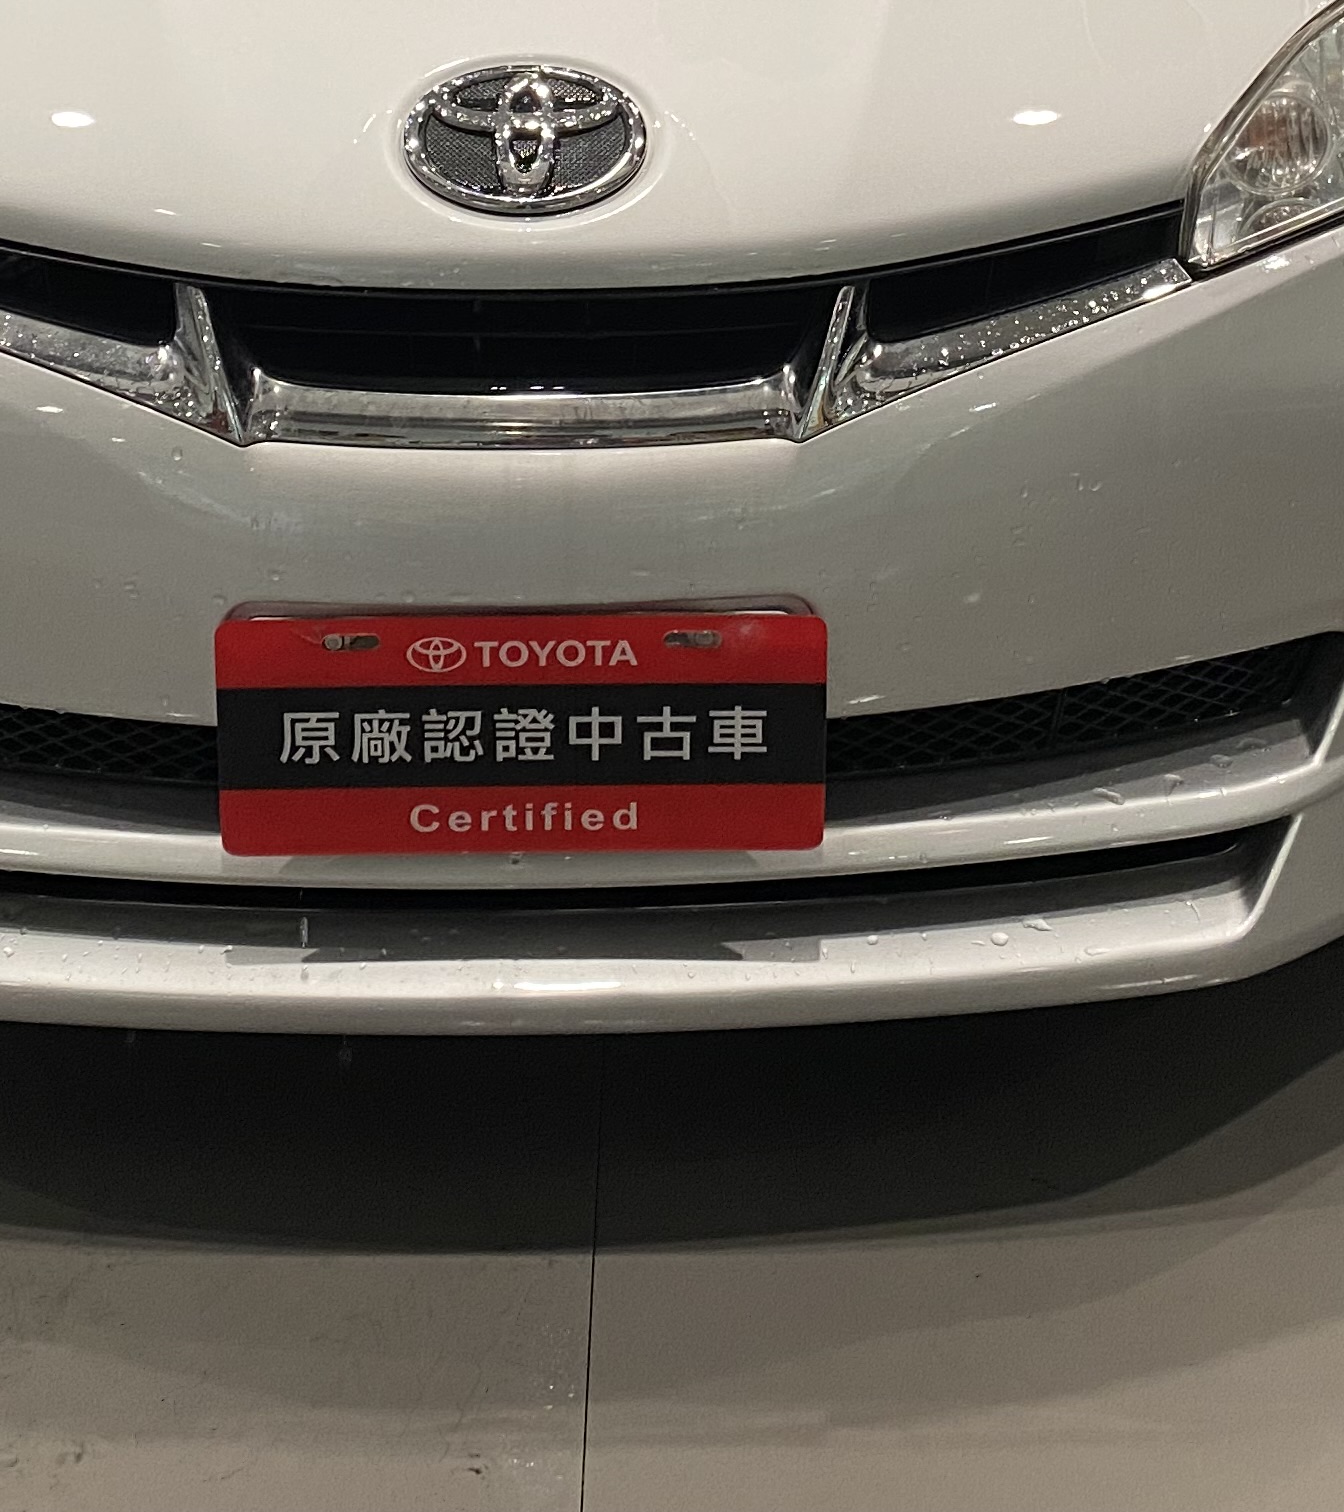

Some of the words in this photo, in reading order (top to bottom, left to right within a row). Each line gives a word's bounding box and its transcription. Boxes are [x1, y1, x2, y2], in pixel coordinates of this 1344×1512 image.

[473, 639, 638, 668] TOYOTA
[278, 705, 769, 765] 原廠認證中古車
[409, 802, 639, 834] Certified
